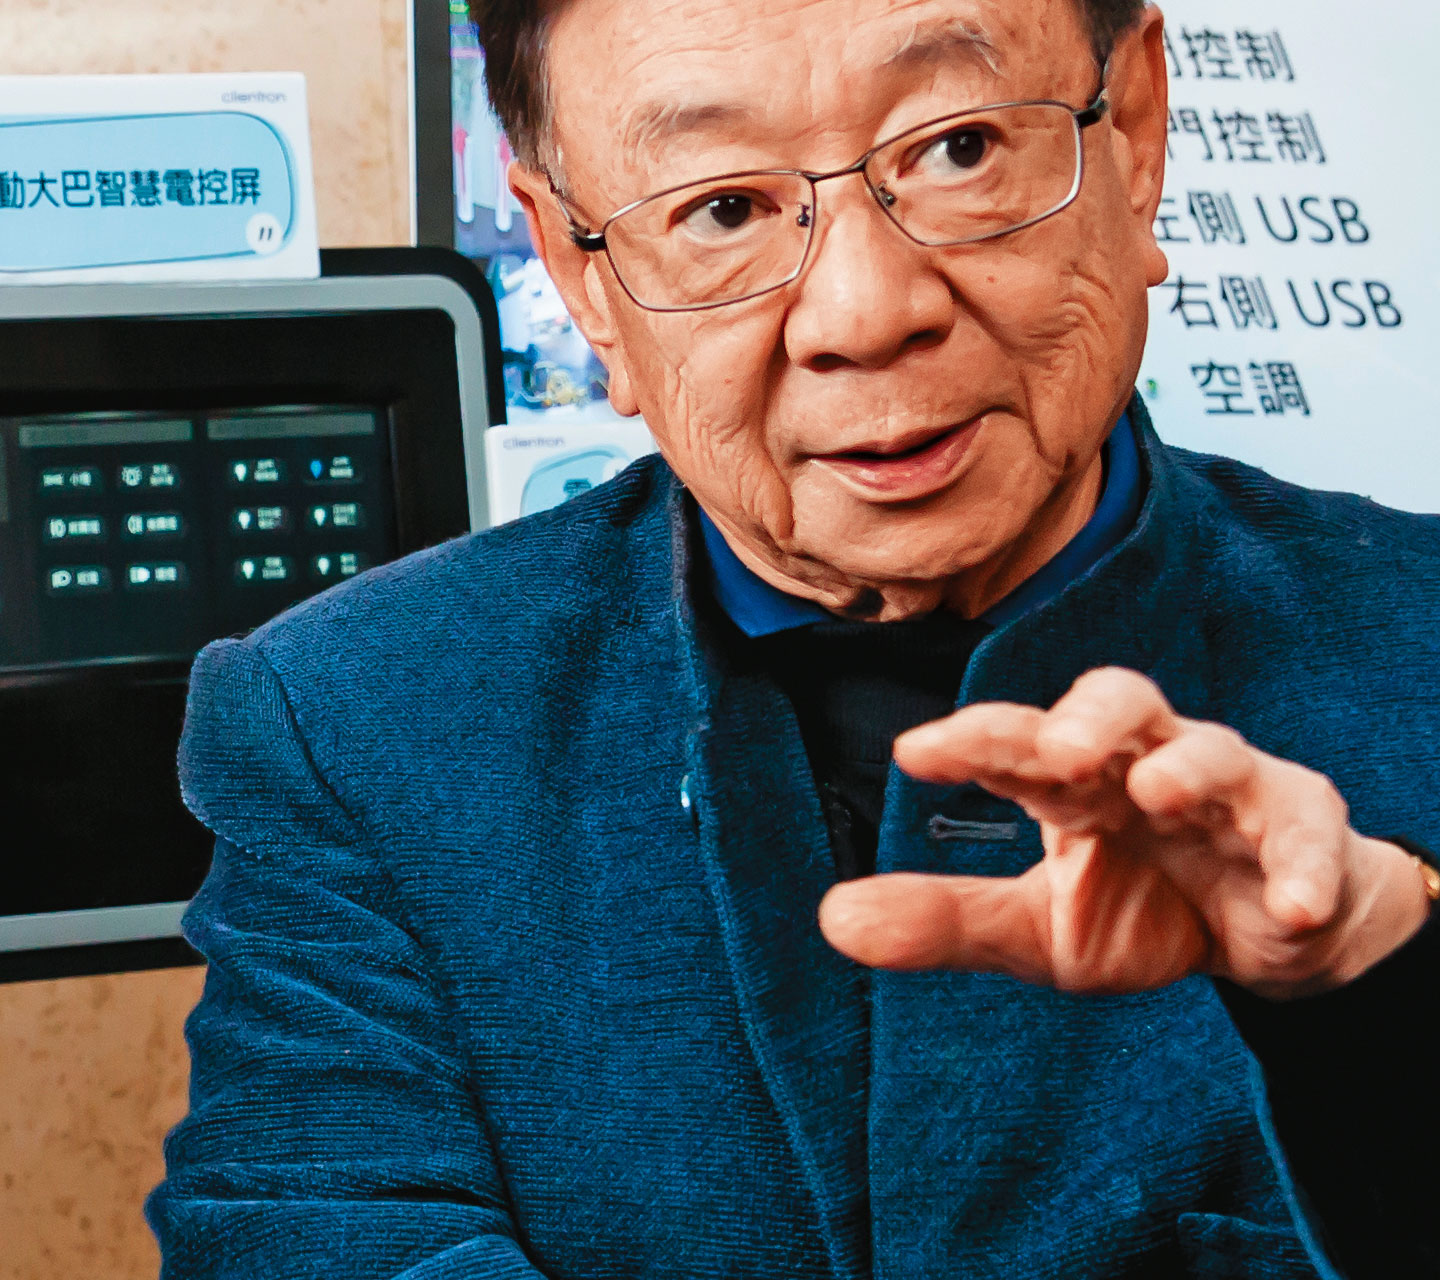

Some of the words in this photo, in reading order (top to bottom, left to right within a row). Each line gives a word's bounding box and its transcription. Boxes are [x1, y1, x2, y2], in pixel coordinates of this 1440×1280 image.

[1254, 193, 1370, 244] USB
[1160, 272, 1279, 331] 右側
[1287, 278, 1402, 328] USB
[1189, 357, 1312, 418] 空調
